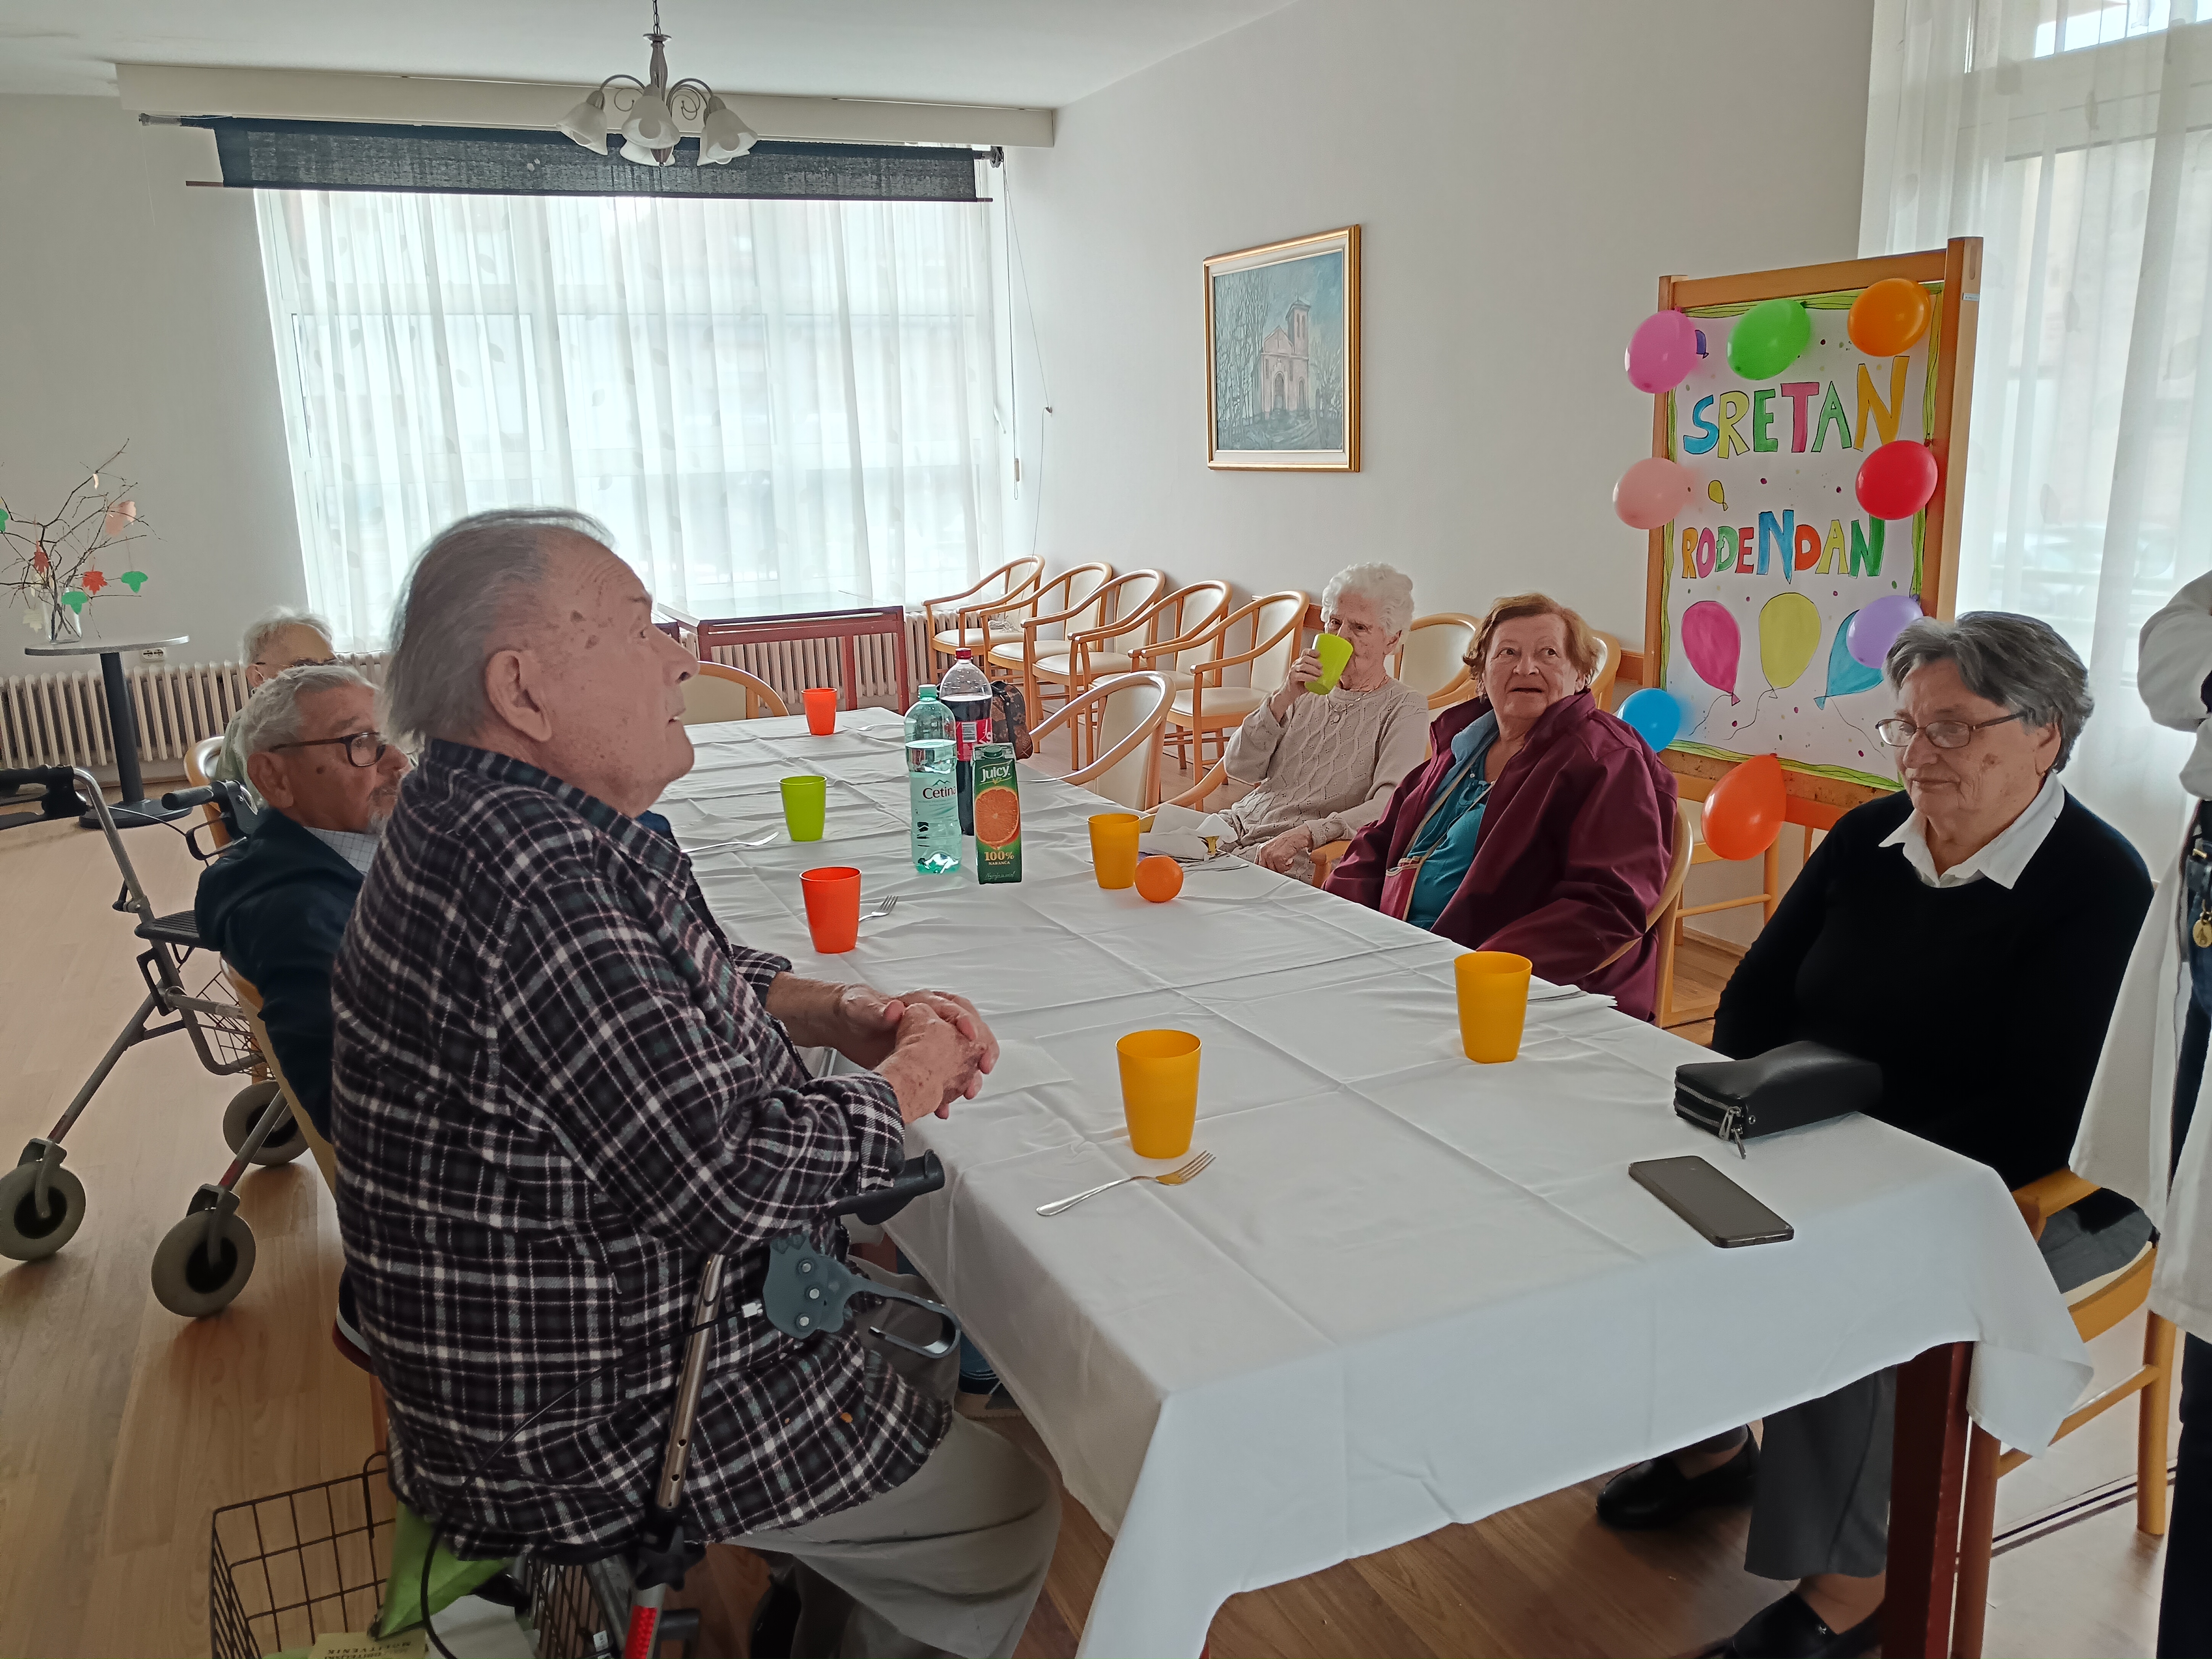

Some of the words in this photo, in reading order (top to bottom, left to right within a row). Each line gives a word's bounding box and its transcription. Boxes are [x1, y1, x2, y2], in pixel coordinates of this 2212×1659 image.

[1683, 356, 1910, 459] SRETAN
[923, 786, 956, 799] Cetina
[984, 851, 1014, 861] 100%
